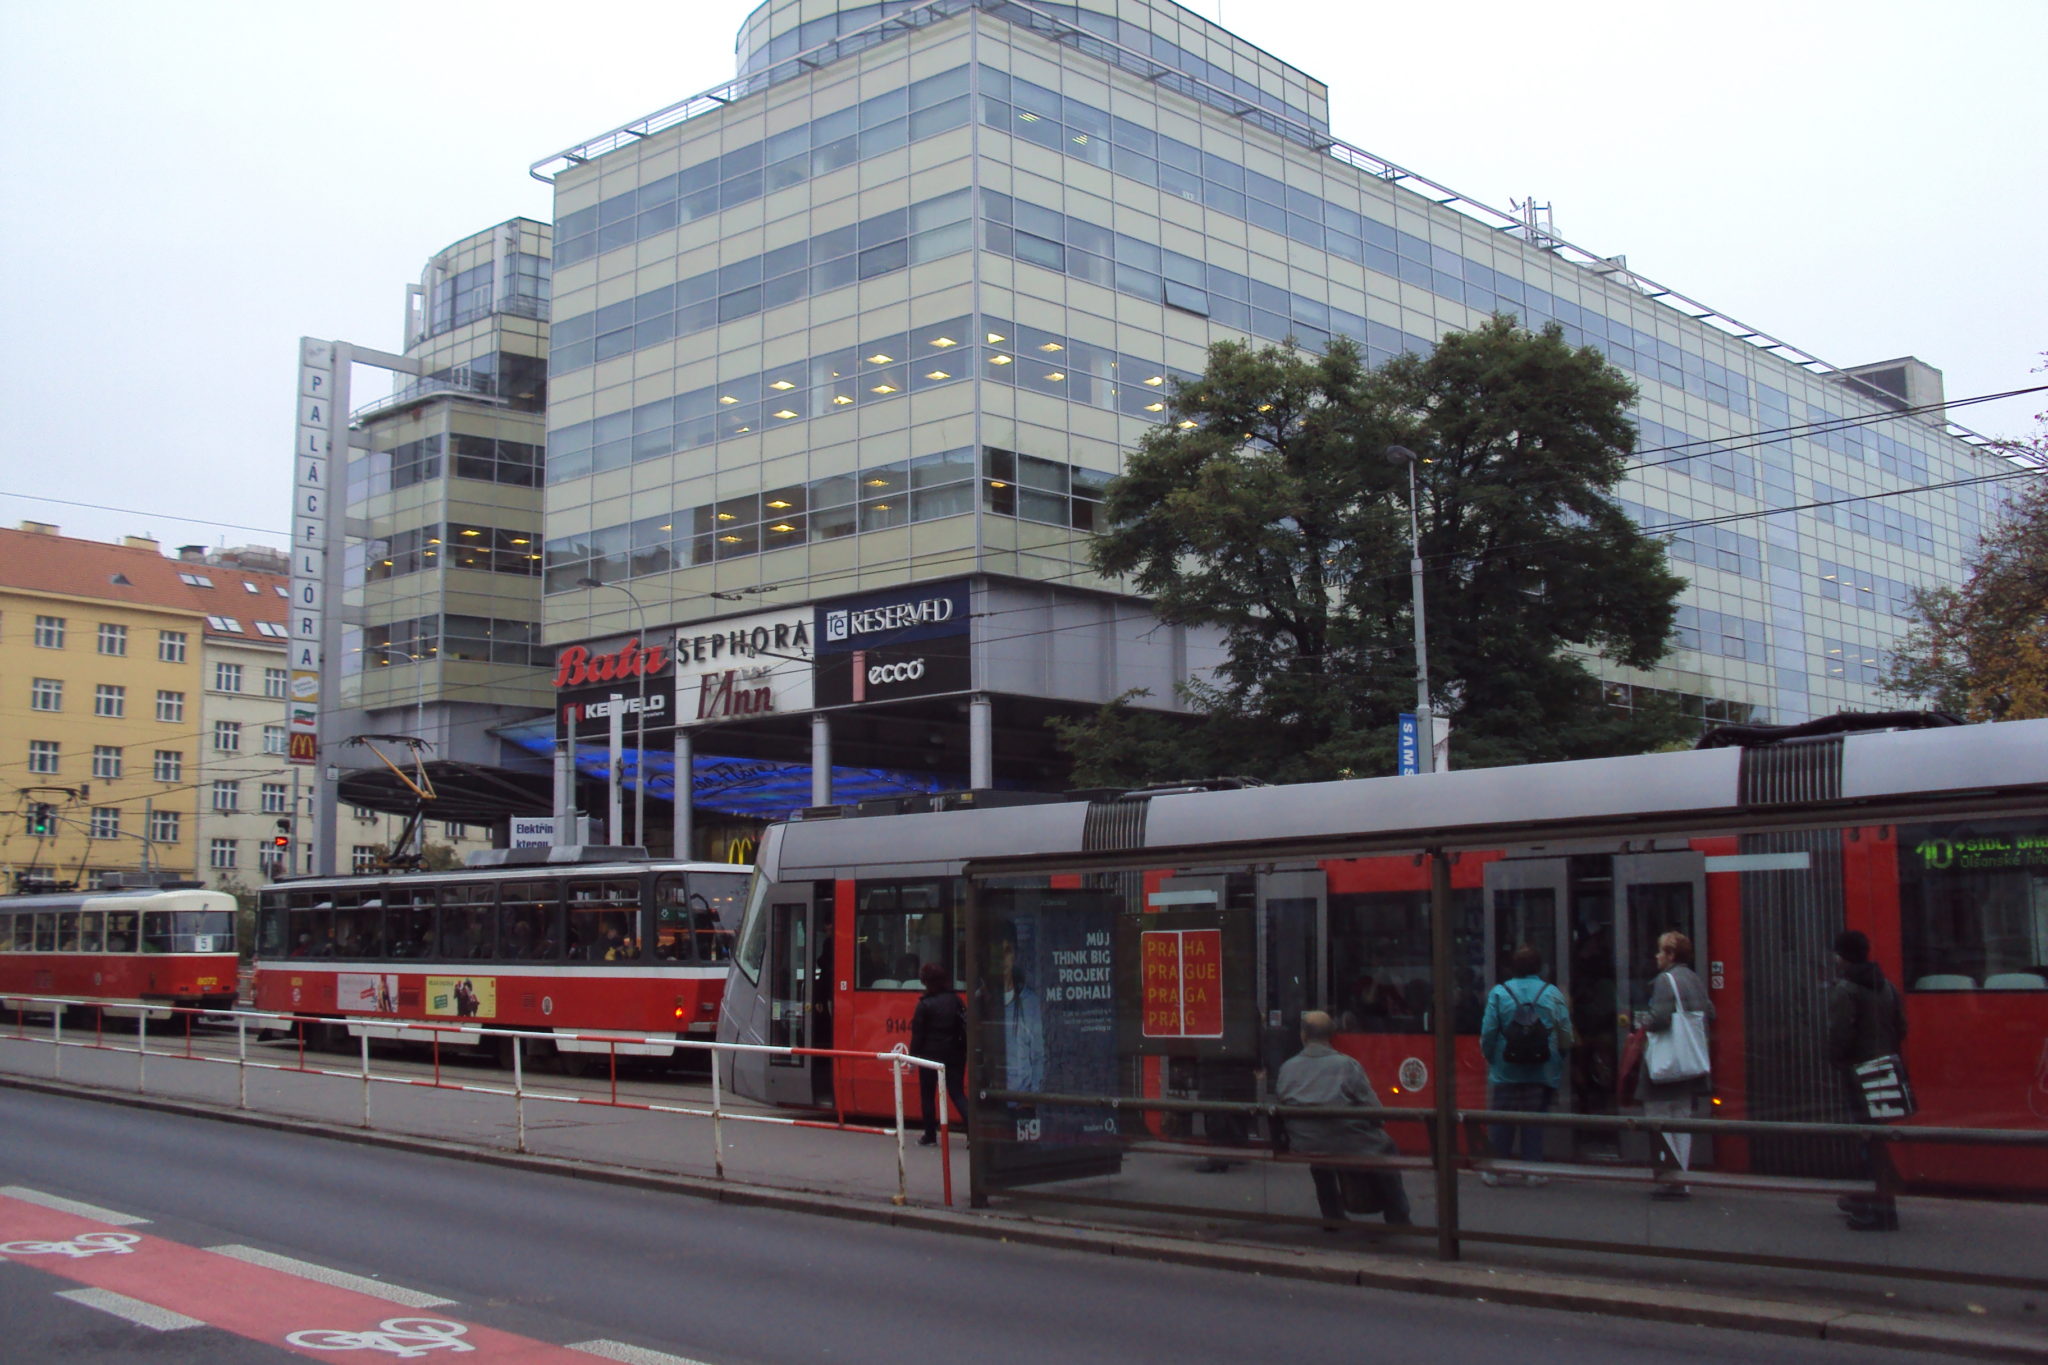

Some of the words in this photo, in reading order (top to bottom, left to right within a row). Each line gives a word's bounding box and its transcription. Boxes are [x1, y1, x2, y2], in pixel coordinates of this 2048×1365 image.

[851, 598, 953, 635] RESERVED
[677, 619, 809, 664] SEPHORA
[868, 659, 925, 685] ecco
[1915, 838, 1953, 869] 10
[1052, 950, 1088, 965] THINK
[1090, 949, 1111, 964] BIG
[1147, 940, 1206, 957] PRAHA
[1058, 967, 1111, 983] PROJEKT
[1148, 962, 1217, 980] PRAGUE
[1148, 986, 1207, 1004] PRAGA
